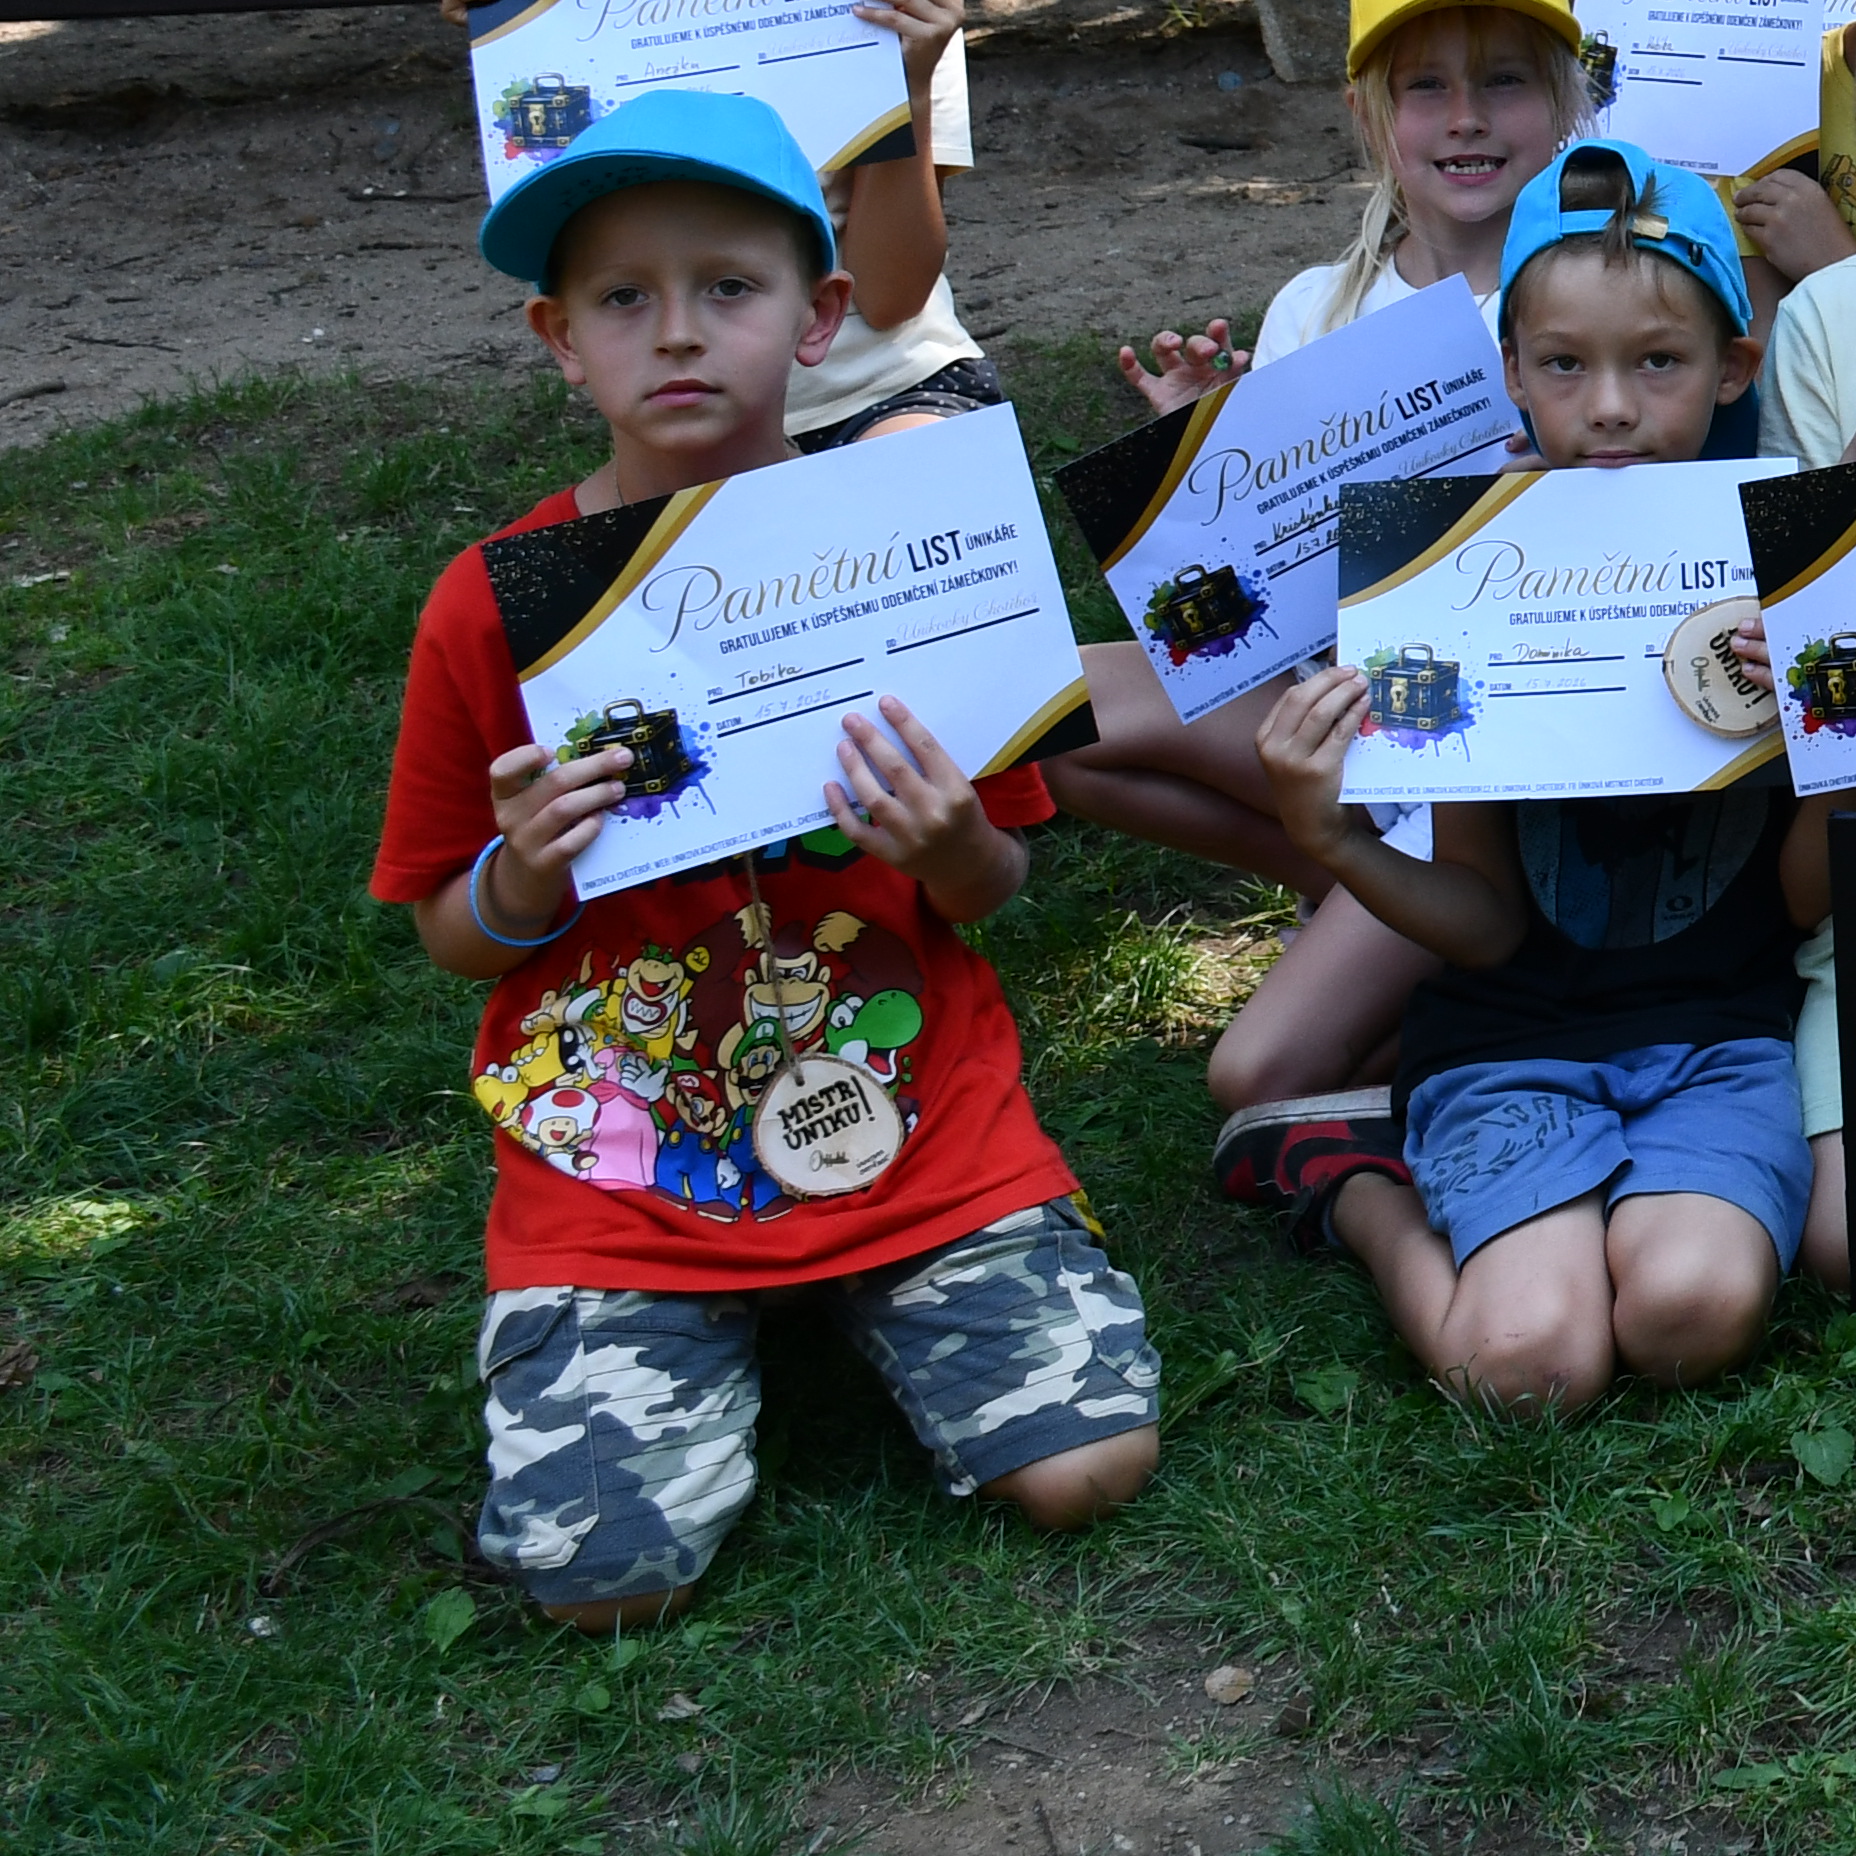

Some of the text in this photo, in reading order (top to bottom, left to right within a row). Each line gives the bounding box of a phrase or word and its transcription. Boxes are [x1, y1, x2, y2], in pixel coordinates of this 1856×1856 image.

[694, 27, 701, 39] K
[1185, 365, 1486, 527] Pamětní LIST ÚNIKÁŘE
[1256, 393, 1490, 517] GRATULUJEME K ÚSPĚŠNÉMU ODEMČENÍ ZÁMEČKOVKY!
[640, 522, 1019, 655] Pamětní LIST ÚNIKÁŘE
[718, 558, 1019, 657] GRATULUJEME K ÚSPĚŠNÉMU ODEMČENÍ ZÁMEČKOVKY!
[1449, 539, 1754, 611] Pamětní LIST ÚNIK
[1508, 609, 1577, 625] GRATULUJEME
[1580, 609, 1587, 621] K
[1589, 603, 1648, 621] ÚSPĚŠNÉMU
[777, 1080, 857, 1130] MISTR
